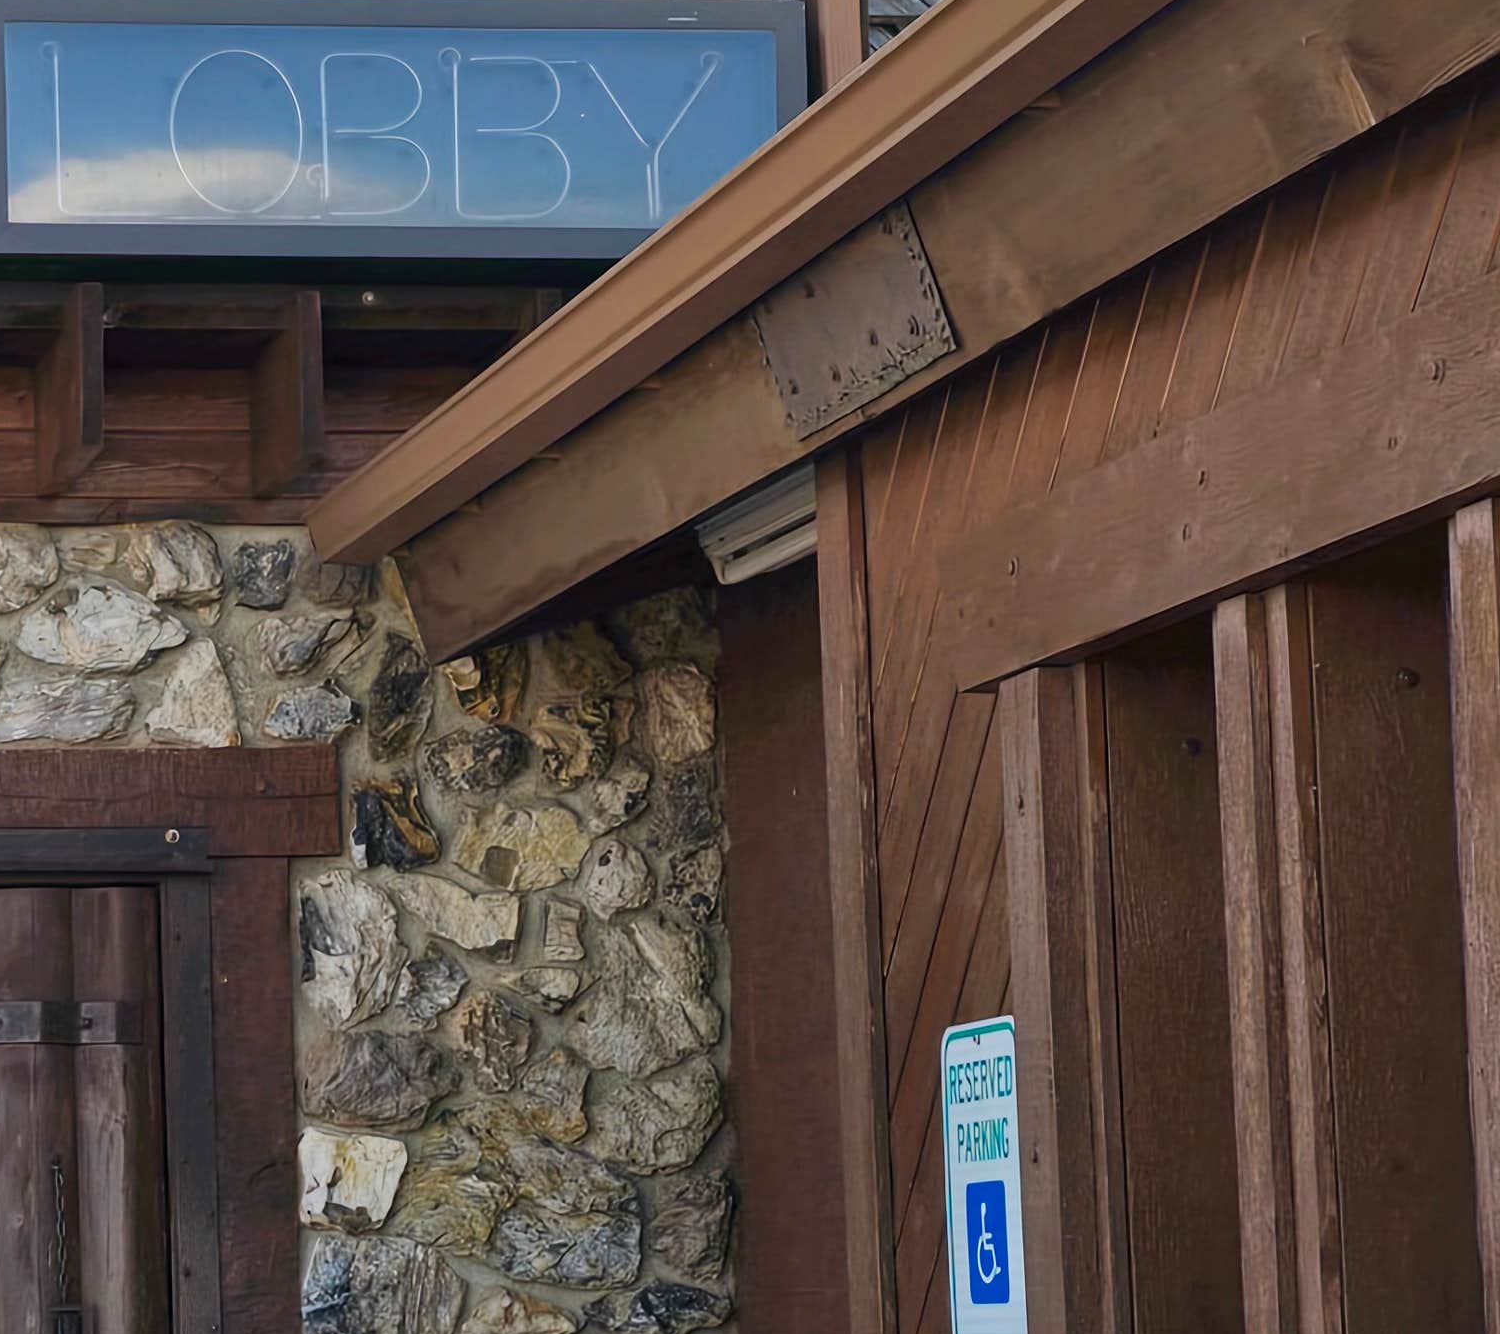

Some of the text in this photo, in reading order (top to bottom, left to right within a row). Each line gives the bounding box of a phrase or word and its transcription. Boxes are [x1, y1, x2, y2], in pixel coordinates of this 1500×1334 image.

[46, 46, 724, 222] LOBBY
[949, 1054, 1014, 1105] RESERVED
[957, 1117, 1010, 1164] PARKING
